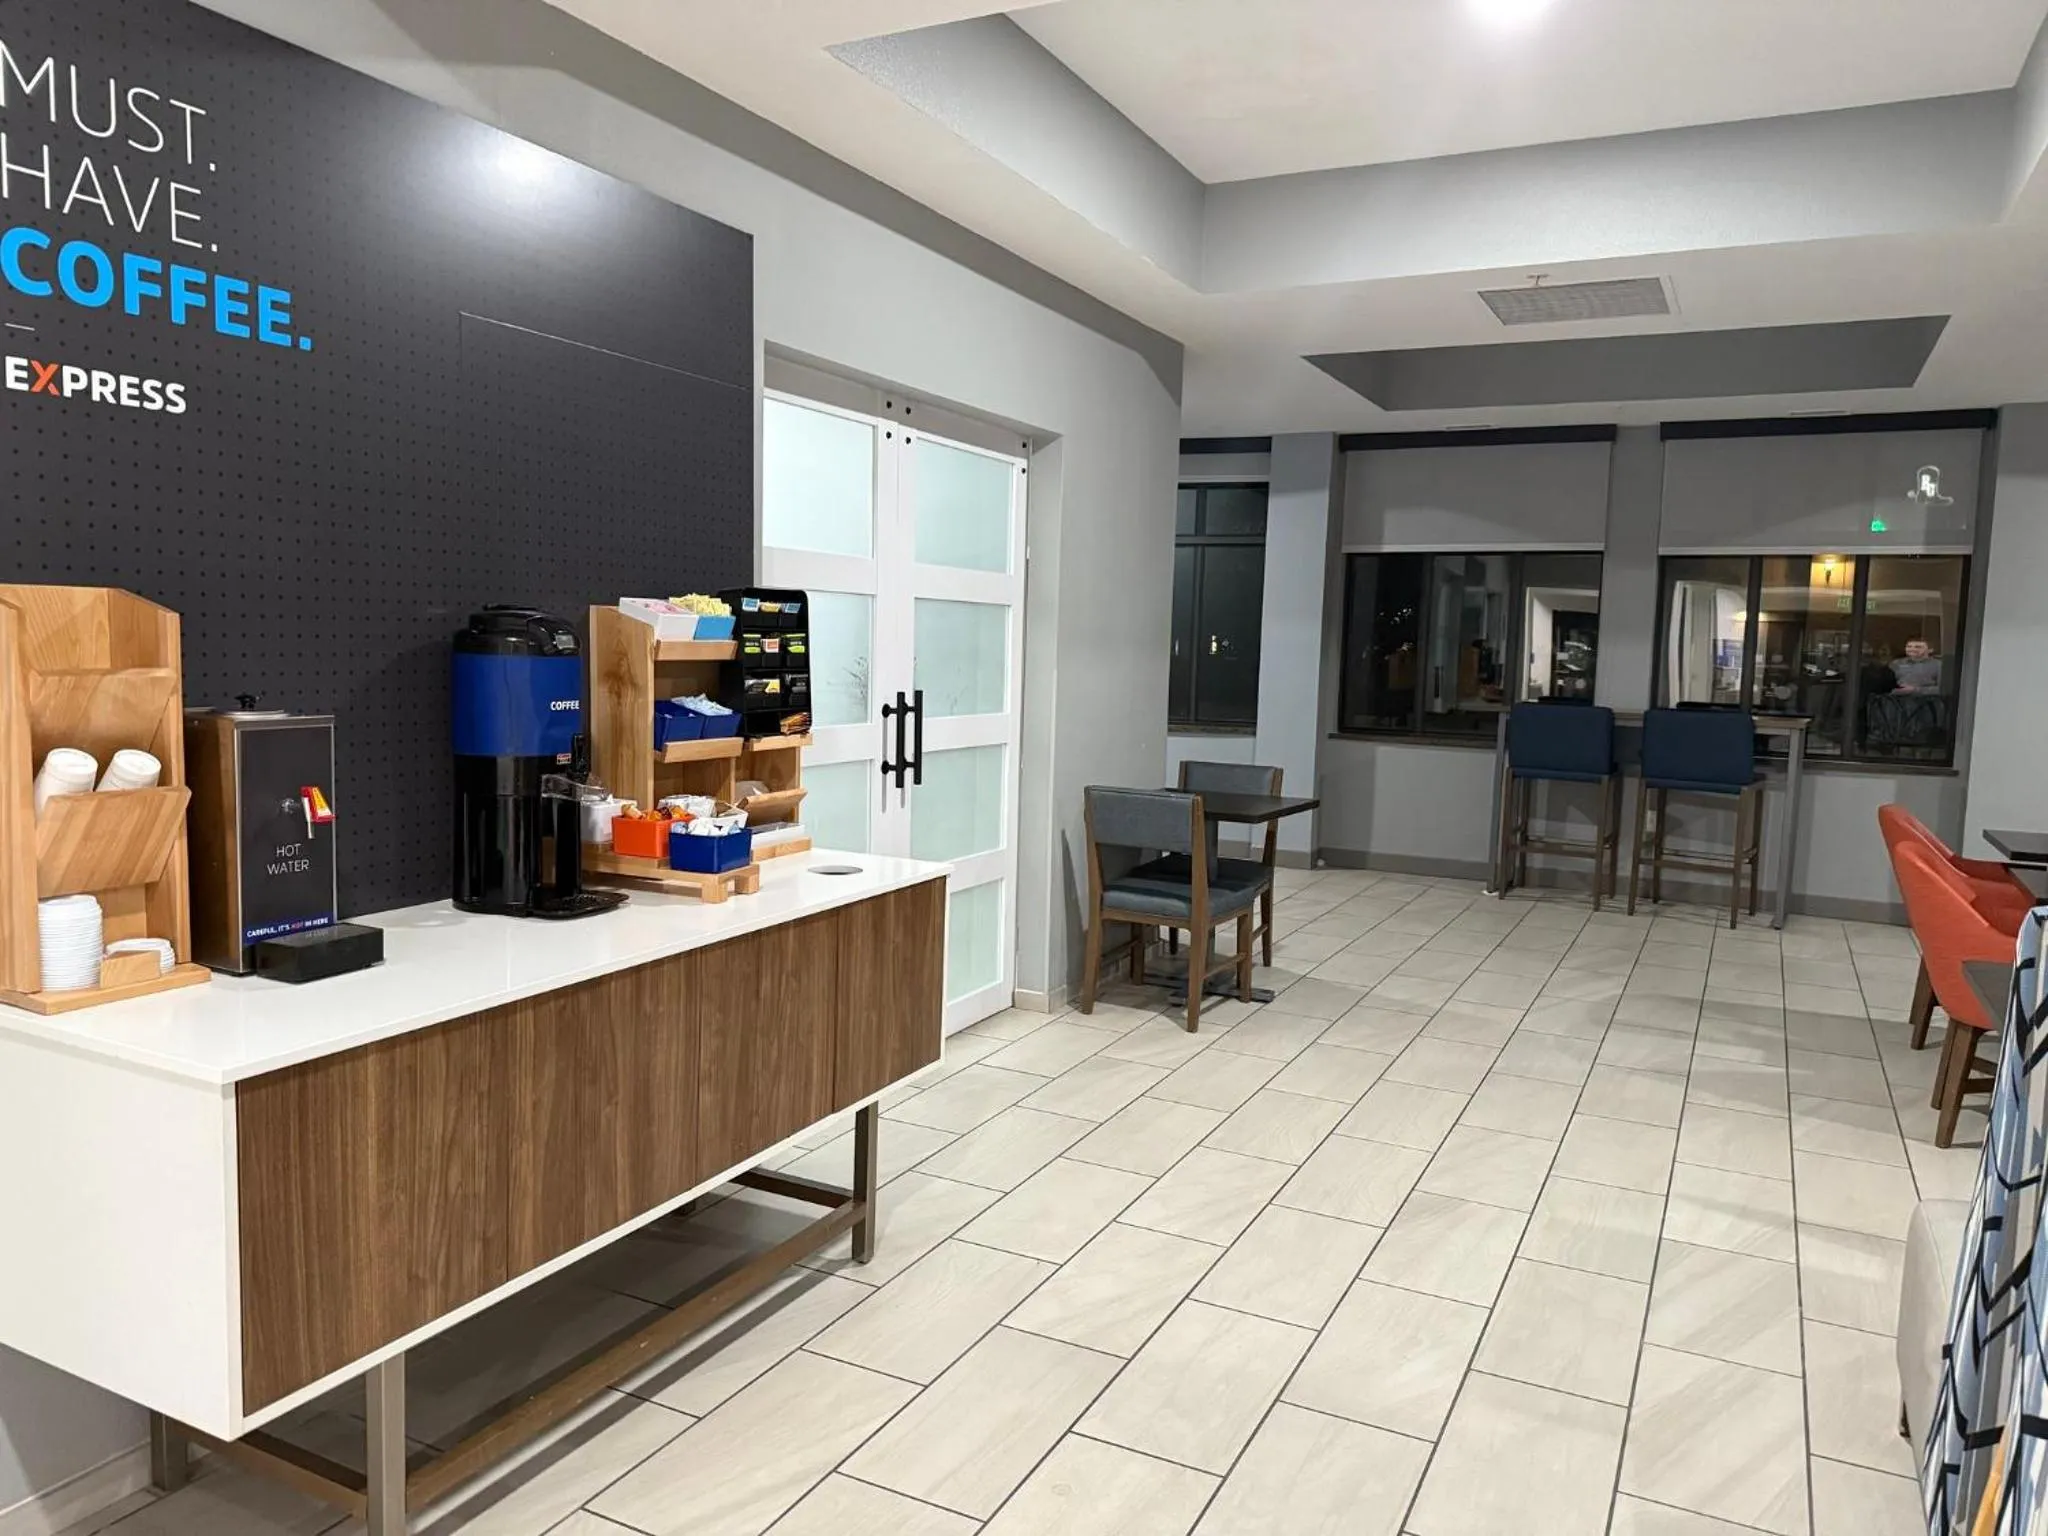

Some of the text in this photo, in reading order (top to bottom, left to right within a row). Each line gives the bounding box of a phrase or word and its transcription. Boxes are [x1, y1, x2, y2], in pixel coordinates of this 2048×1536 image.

[0, 40, 216, 173] MUST.
[0, 132, 218, 252] HAVE.
[0, 227, 312, 351] COFFEE.
[5, 355, 187, 414] EXPRESS
[550, 700, 580, 711] COFFEE
[267, 859, 310, 875] WATER
[276, 843, 302, 857] HOT
